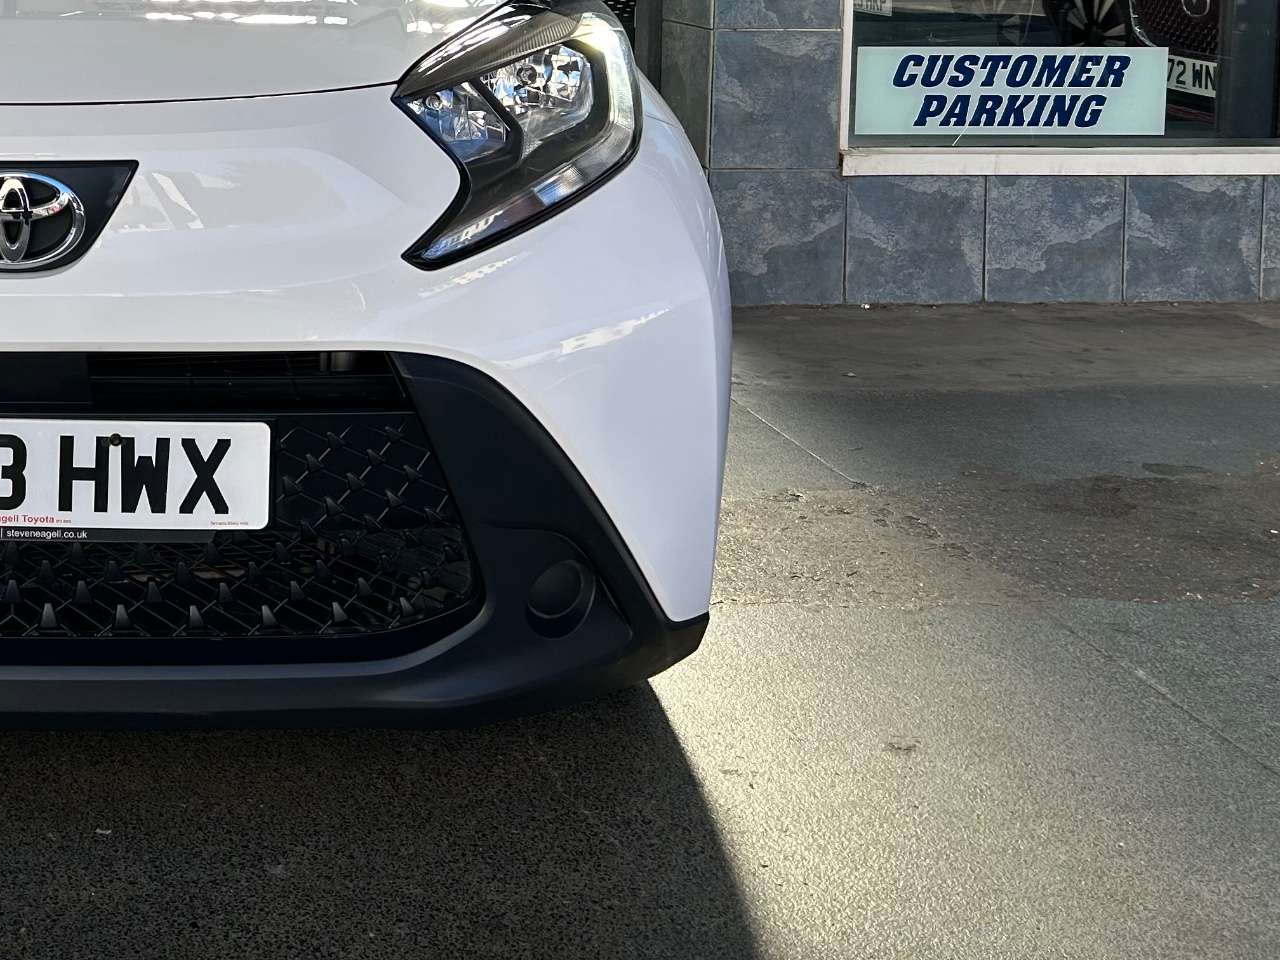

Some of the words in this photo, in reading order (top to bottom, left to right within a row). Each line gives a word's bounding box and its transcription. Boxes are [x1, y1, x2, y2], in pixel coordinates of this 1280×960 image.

[892, 54, 1132, 89] CUSTOMER
[1167, 59, 1186, 86] 72
[912, 94, 1108, 129] PARKING
[58, 435, 232, 516] HWX
[6, 529, 88, 540] steveneagell.co.uk
[22, 515, 55, 525] Toyota
